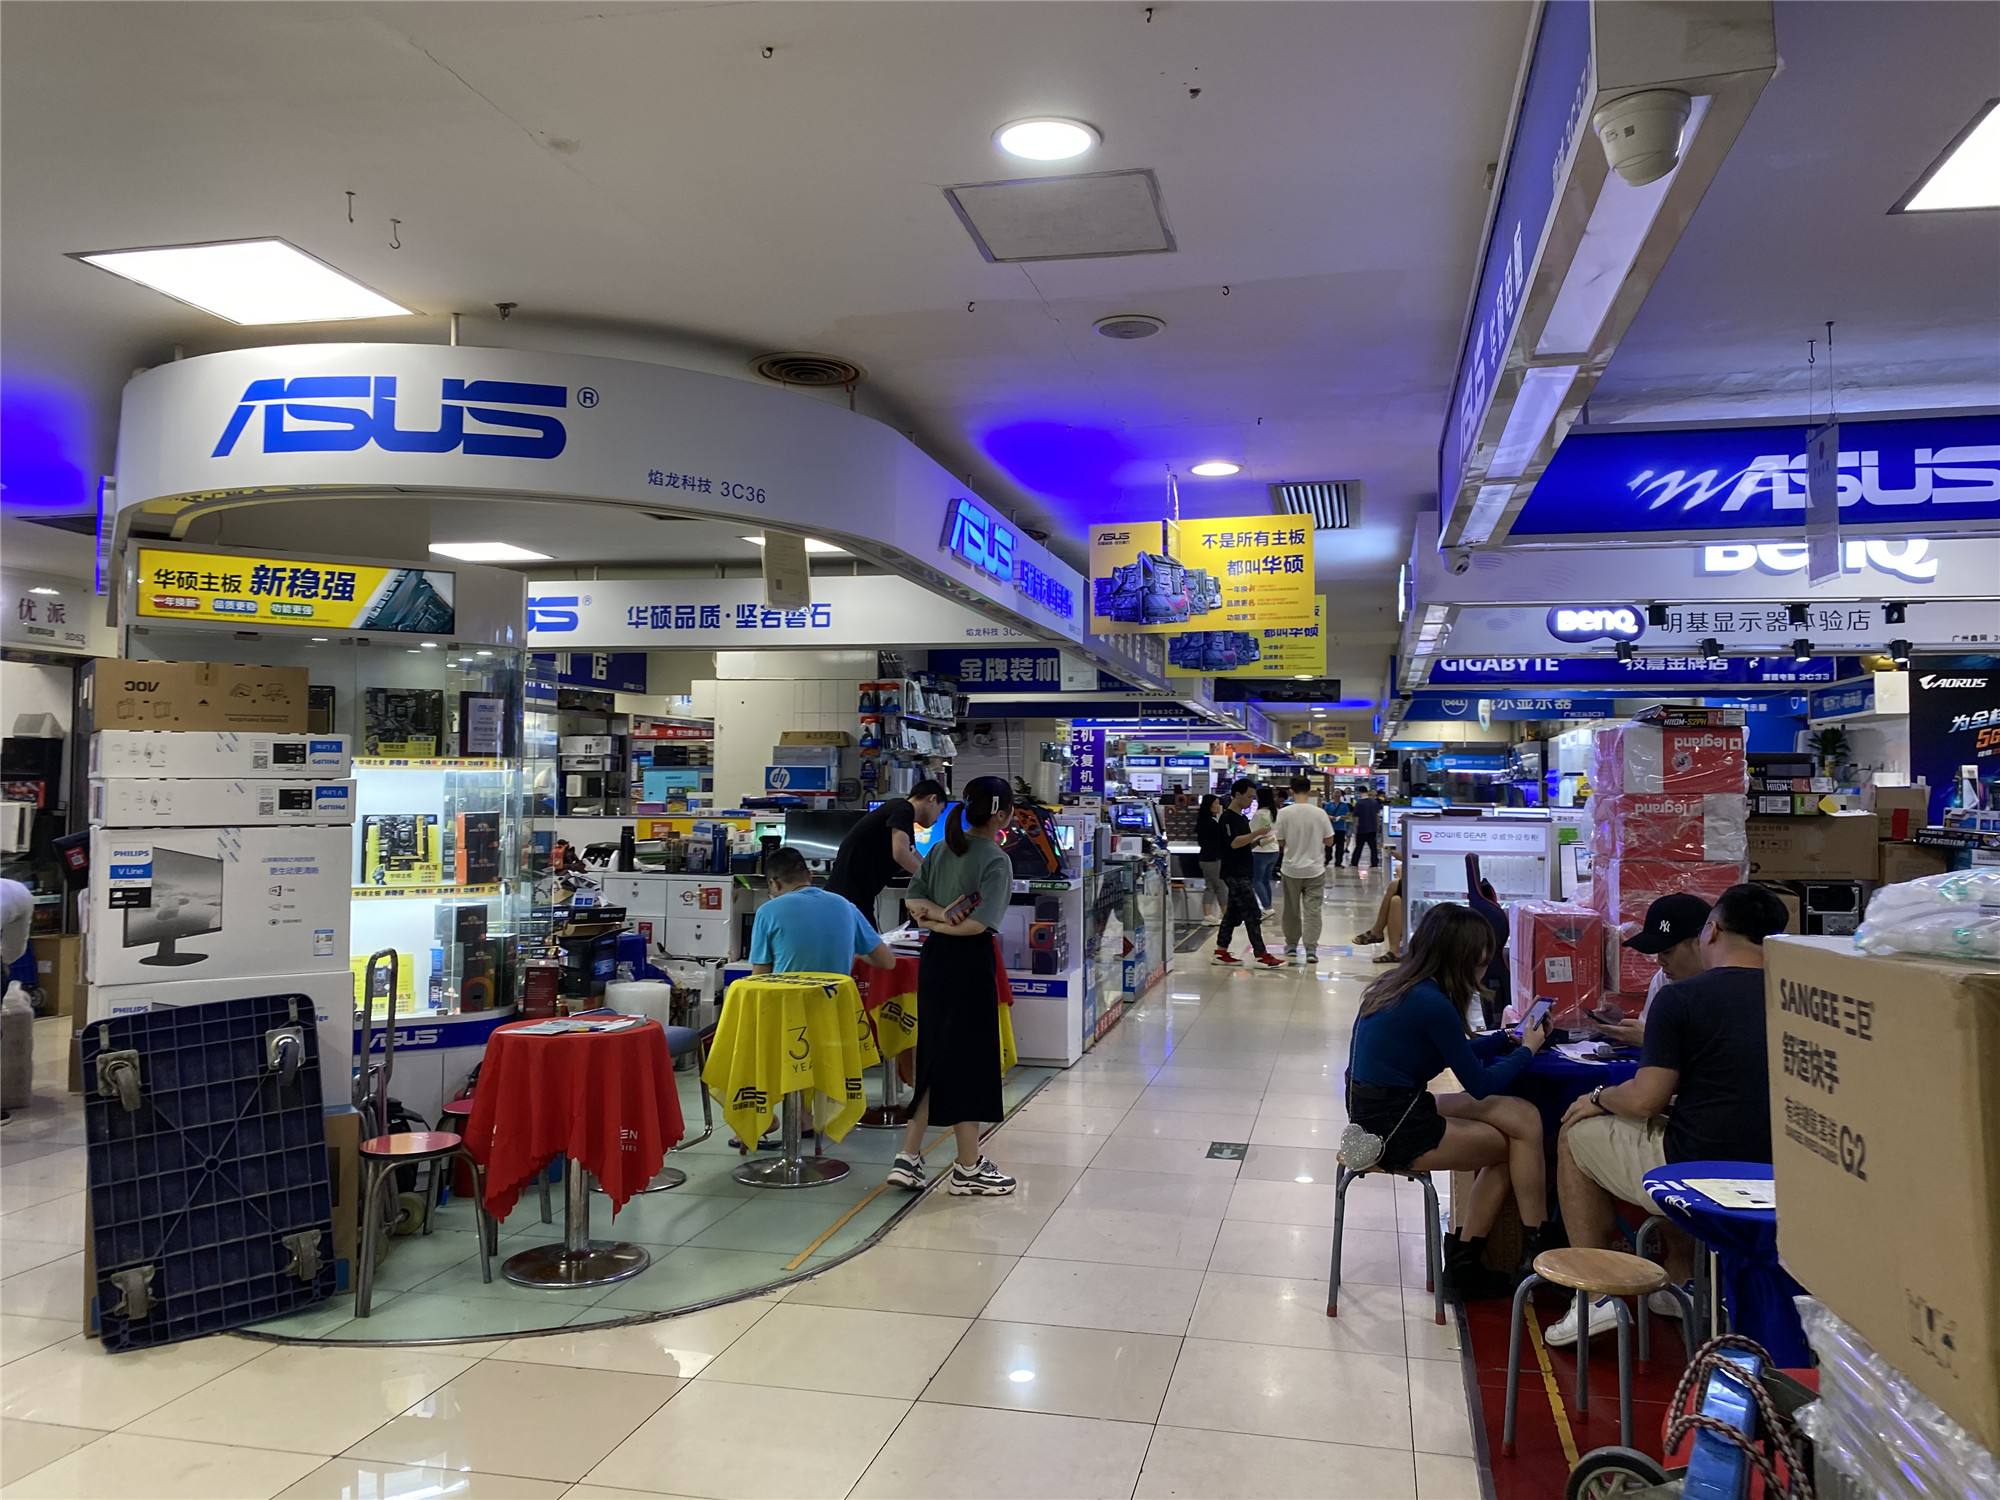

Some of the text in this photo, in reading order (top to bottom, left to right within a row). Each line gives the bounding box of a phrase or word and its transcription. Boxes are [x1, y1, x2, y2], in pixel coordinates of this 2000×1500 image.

[211, 375, 567, 460] ASUS
[648, 469, 766, 503] 焰龙科技 3C36
[949, 497, 1014, 582] ASUS
[1097, 532, 1130, 541] ASUS
[1202, 528, 1306, 549] 不是所有主板
[1227, 554, 1305, 576] 都叫华硕
[153, 563, 357, 602] 华硕主板 新稳强
[18, 598, 66, 624] 优派
[212, 599, 258, 612] 品质更稳
[271, 602, 314, 615] 功能更强
[1557, 608, 1639, 634] BenQ
[960, 657, 1059, 682] 金牌装机
[1440, 658, 1559, 672] GIGABYTE
[1932, 678, 1989, 689] AORUS
[1674, 737, 1727, 750] legrand
[1434, 831, 1462, 839] ZOWIE
[1779, 977, 1873, 1042] SANGEE 三巨
[788, 1026, 810, 1060] 3
[1839, 1124, 1869, 1183] G2
